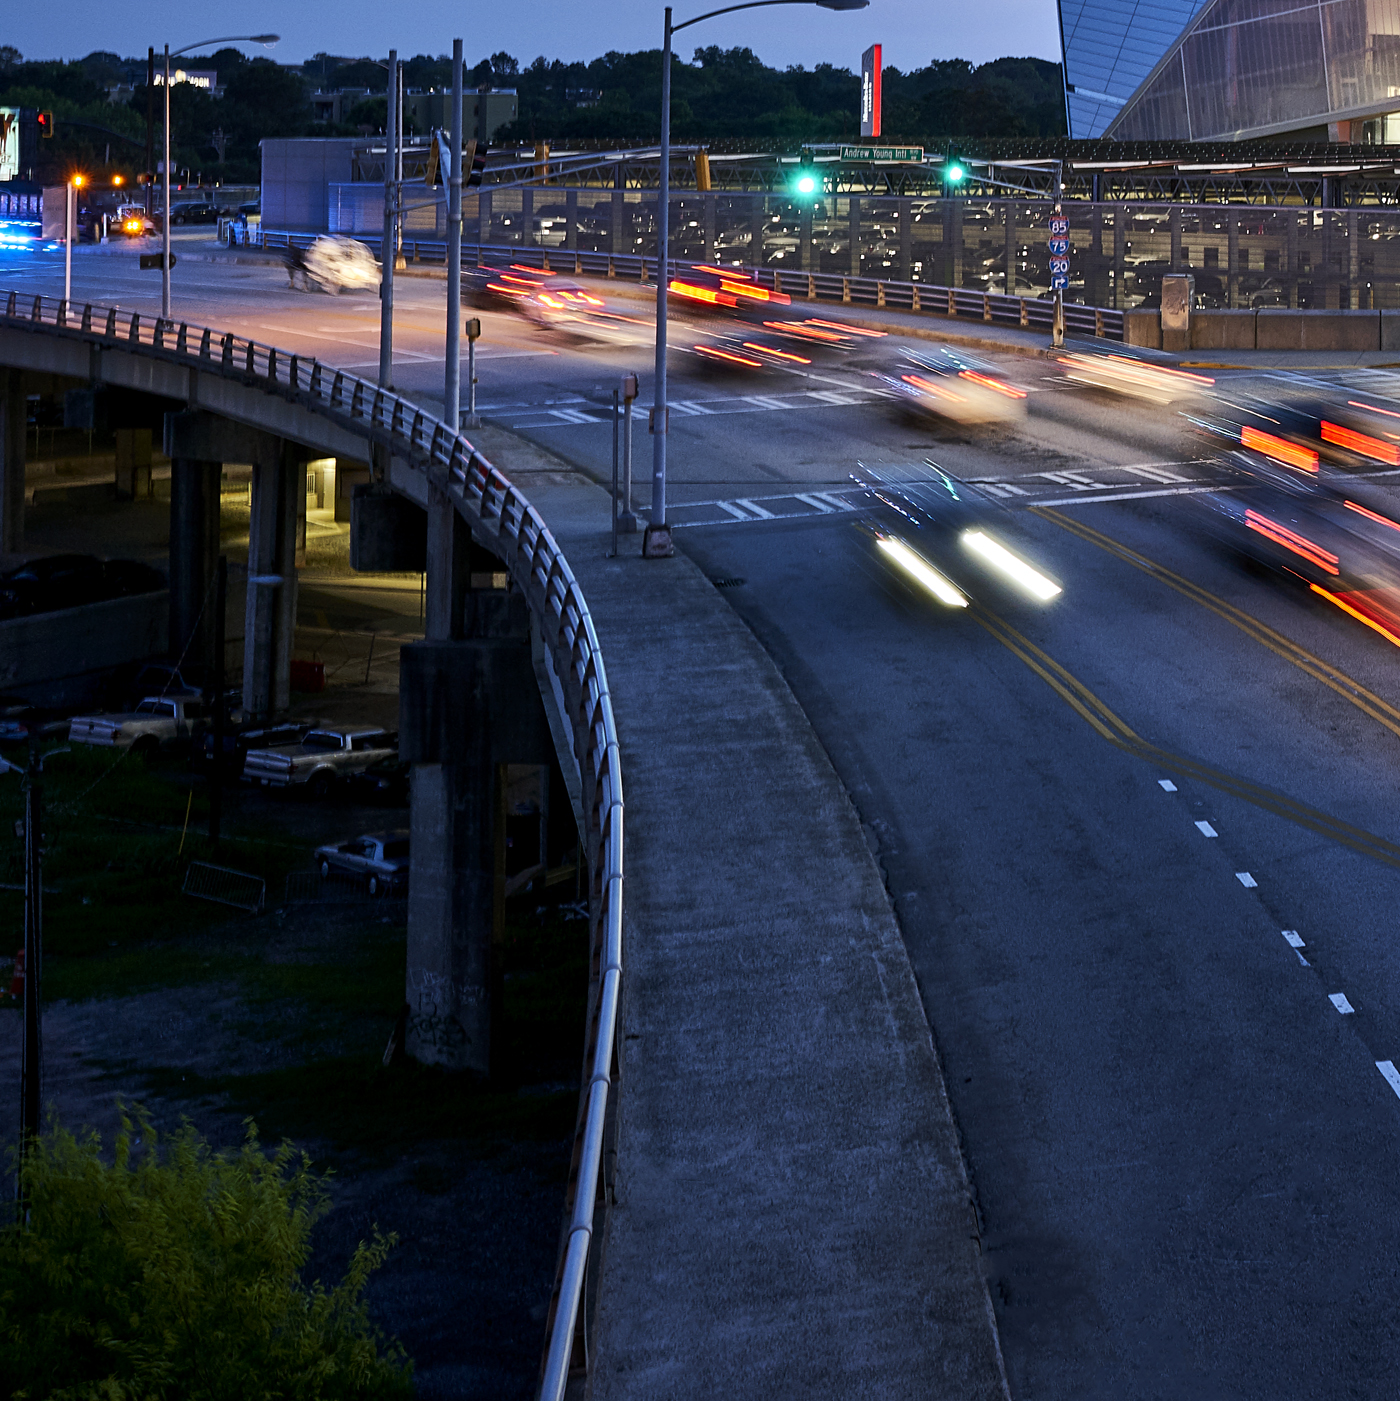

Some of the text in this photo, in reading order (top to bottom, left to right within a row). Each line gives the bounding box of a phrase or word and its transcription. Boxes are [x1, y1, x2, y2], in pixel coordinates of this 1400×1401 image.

[843, 148, 870, 158] Andrew
[872, 148, 893, 161] Young
[1052, 221, 1067, 234] 85
[1052, 242, 1066, 252] 75
[1053, 261, 1068, 273] 20
